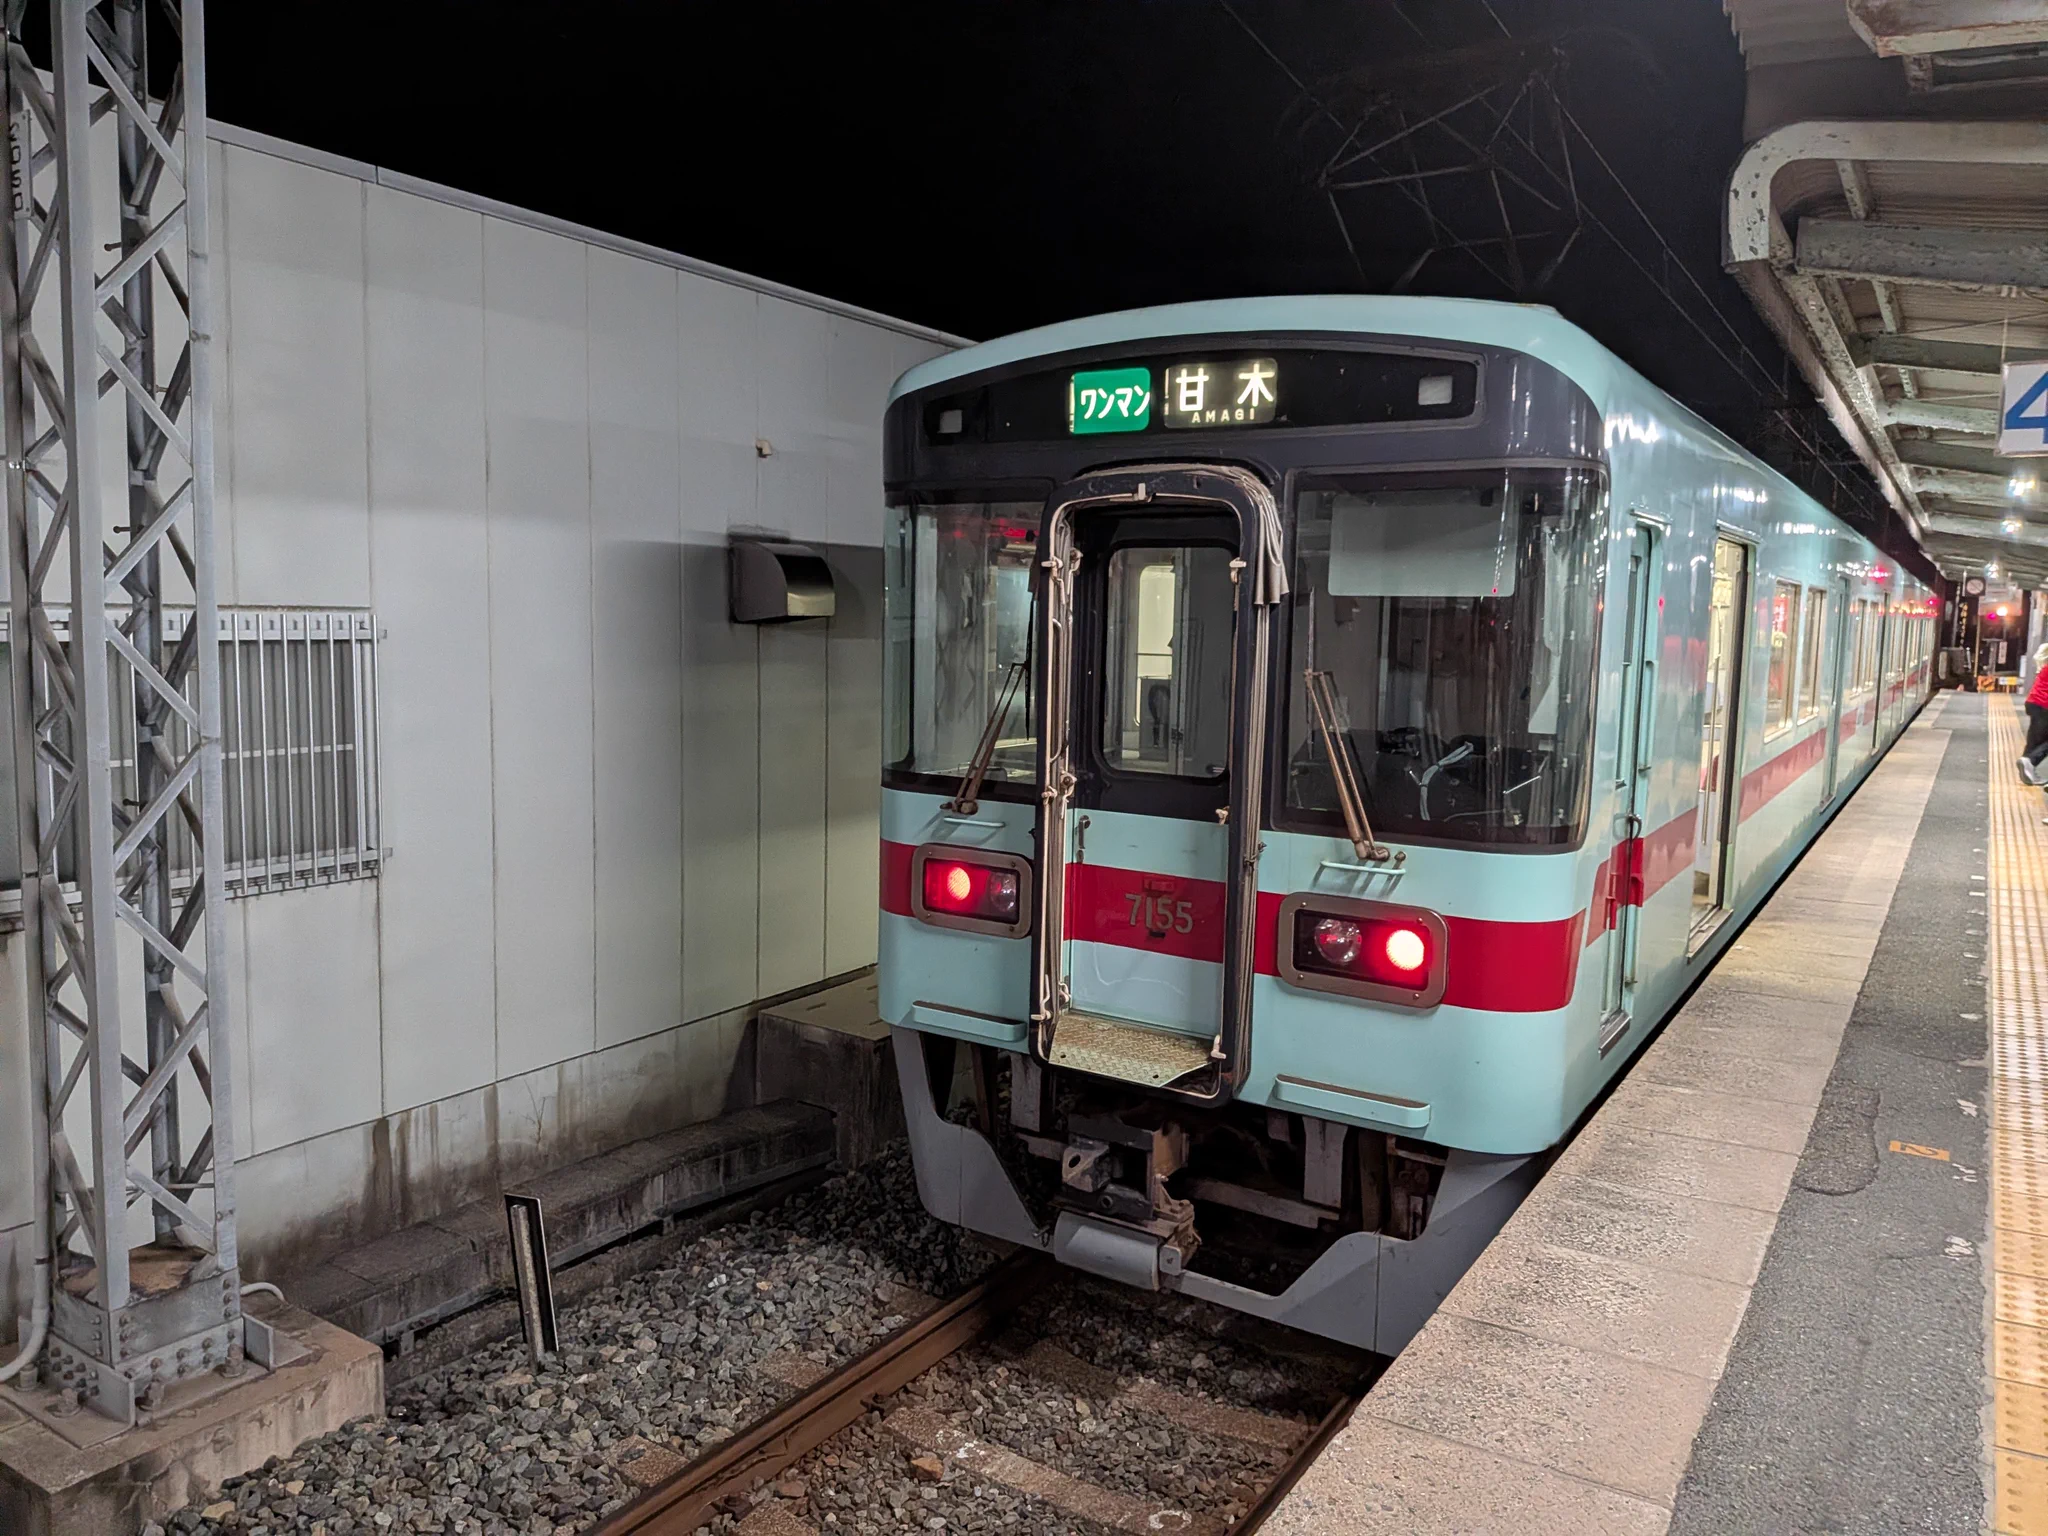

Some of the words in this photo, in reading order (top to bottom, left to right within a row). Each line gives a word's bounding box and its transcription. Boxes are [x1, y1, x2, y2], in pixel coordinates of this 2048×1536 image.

[1080, 385, 1150, 419] ワンマン
[1176, 363, 1275, 411] 甘木
[2004, 371, 2048, 444] 4
[1191, 408, 1255, 423] AMAGI
[1125, 893, 1194, 934] 7155
